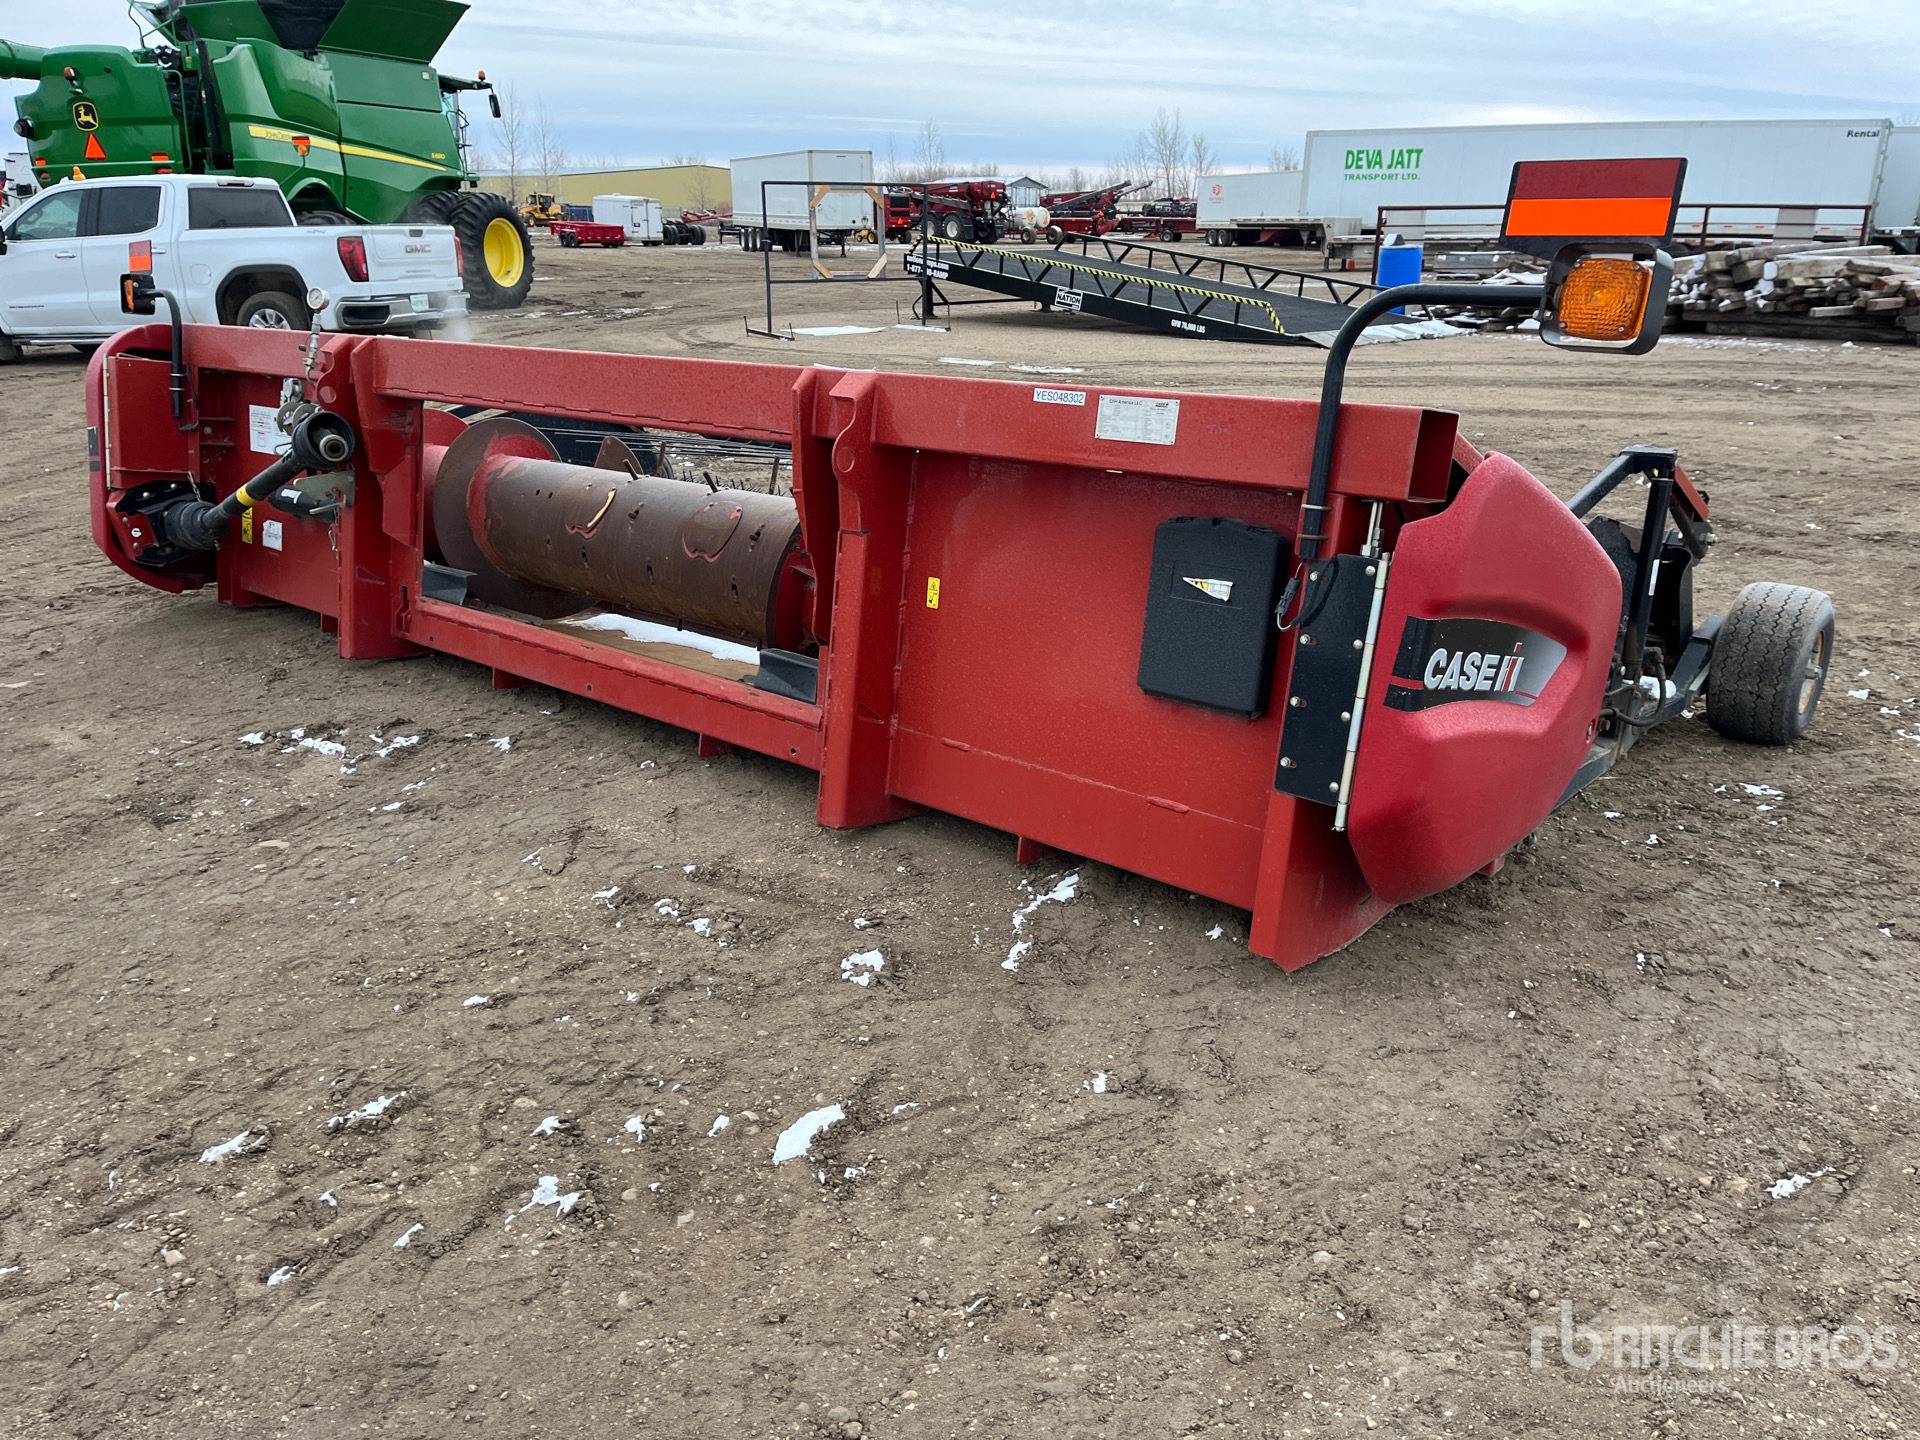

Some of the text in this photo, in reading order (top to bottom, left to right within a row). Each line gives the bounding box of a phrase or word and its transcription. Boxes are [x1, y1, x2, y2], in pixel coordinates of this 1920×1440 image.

[1846, 129, 1880, 138] Rental
[1344, 147, 1424, 170] DEVA JATT
[1343, 172, 1421, 181] TRANSPORT LTD.
[404, 244, 432, 254] GMC
[1056, 292, 1081, 305] NATION
[1035, 389, 1085, 405] YES048302
